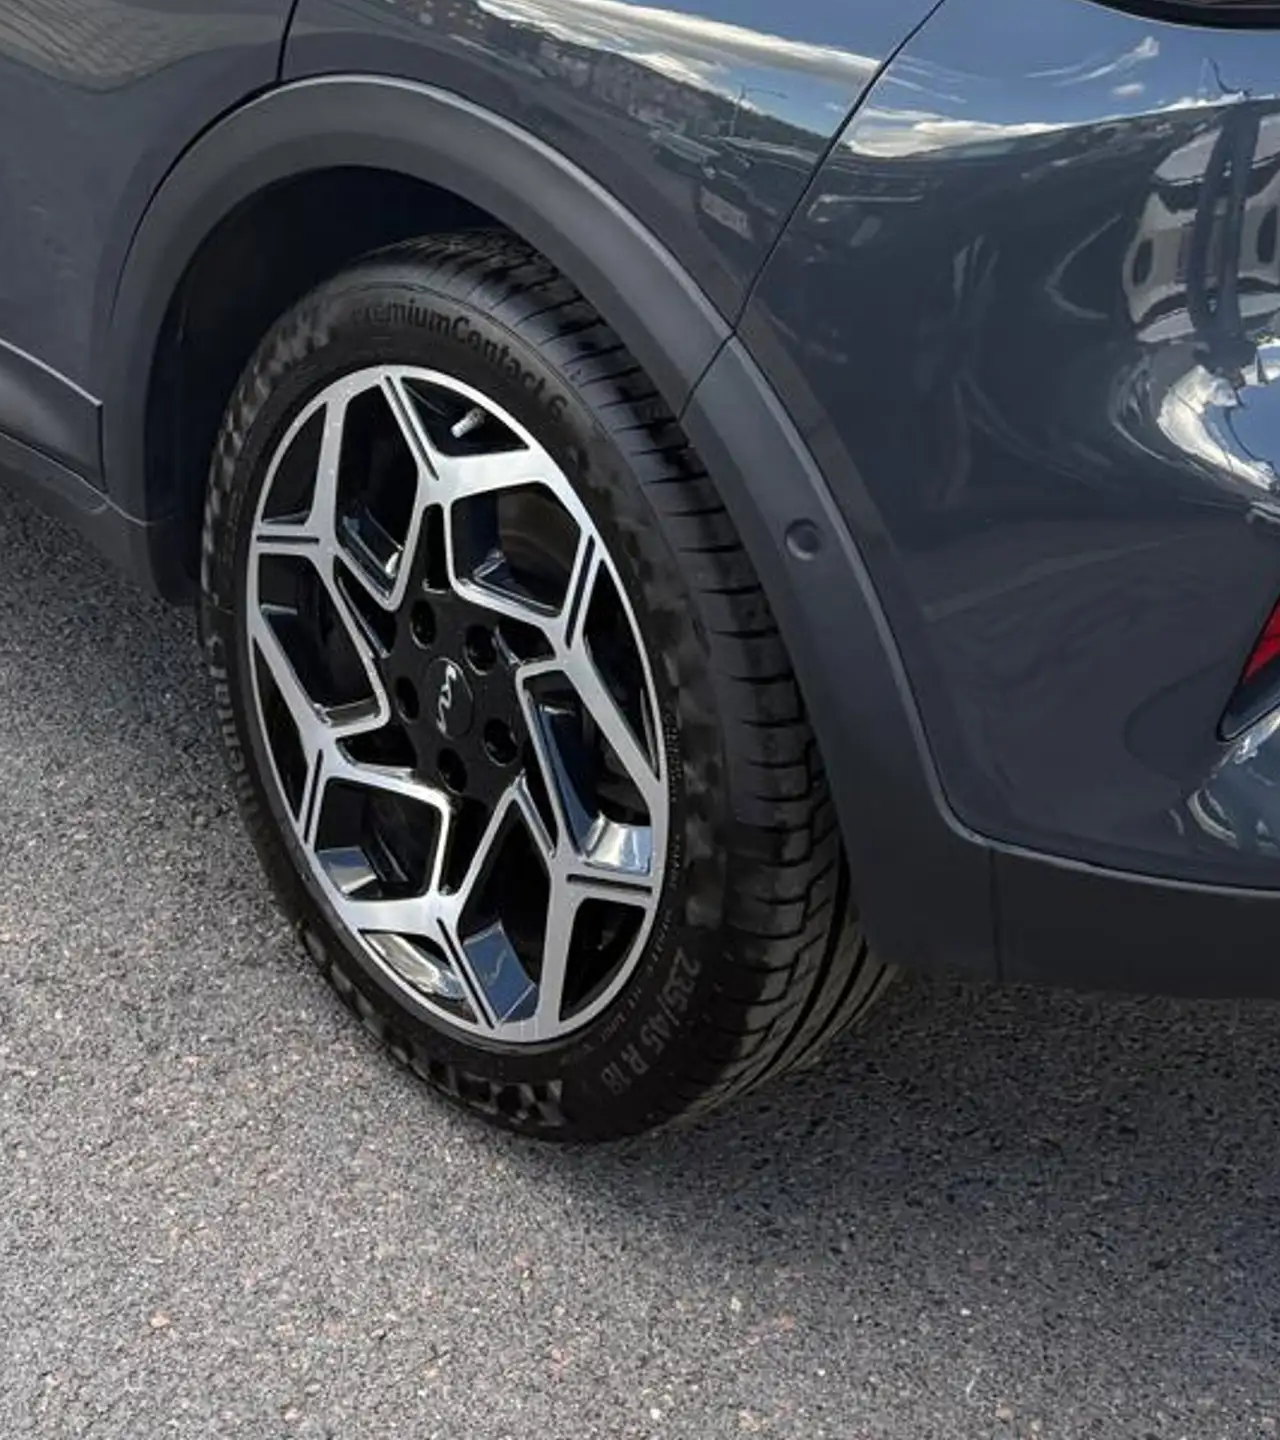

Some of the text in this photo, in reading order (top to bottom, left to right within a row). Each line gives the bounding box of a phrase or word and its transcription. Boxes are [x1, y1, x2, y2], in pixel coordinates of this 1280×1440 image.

[640, 946, 702, 1056] 235/45
[620, 1043, 650, 1076] R
[600, 1061, 632, 1098] 18
